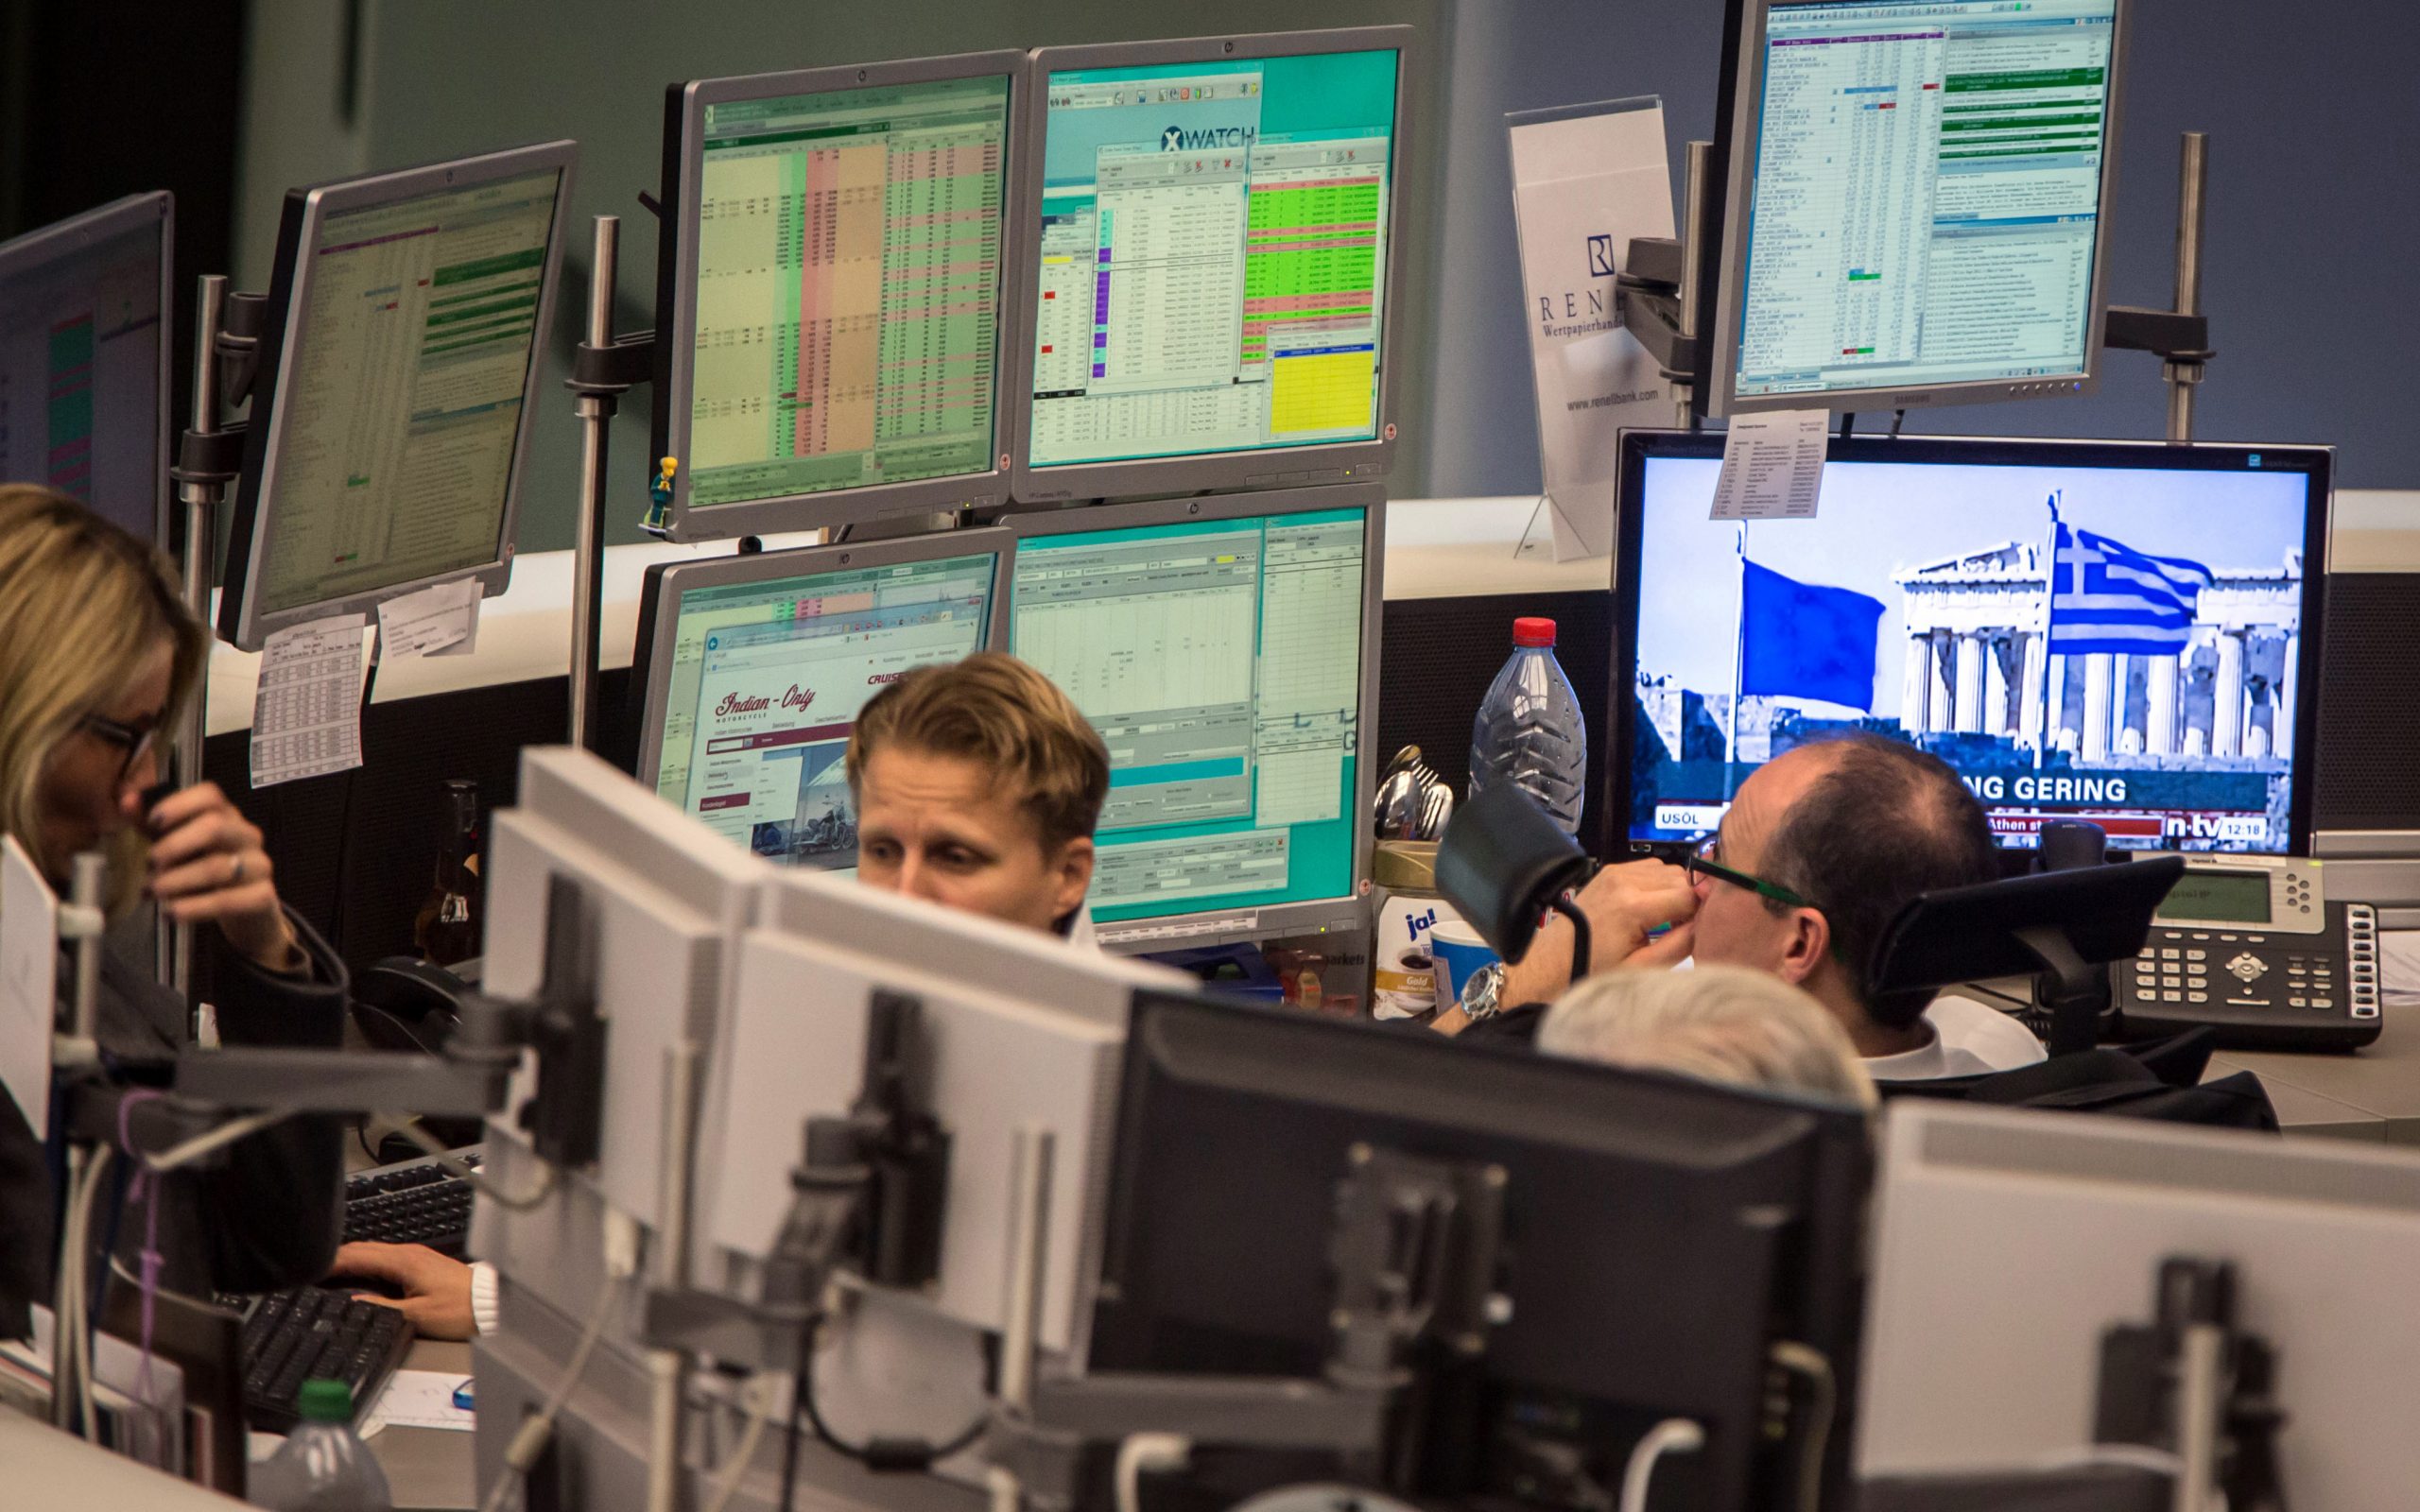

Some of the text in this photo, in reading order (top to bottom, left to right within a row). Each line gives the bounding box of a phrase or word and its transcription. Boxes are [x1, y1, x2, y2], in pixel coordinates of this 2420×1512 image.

[1566, 389, 1659, 412] www.renellbank.com
[715, 692, 770, 716] Indian
[781, 683, 817, 712] Only
[2014, 777, 2126, 801] GERING
[2227, 825, 2260, 835] 12:18
[1406, 907, 1437, 942] ja!
[1407, 976, 1428, 987] Gold
